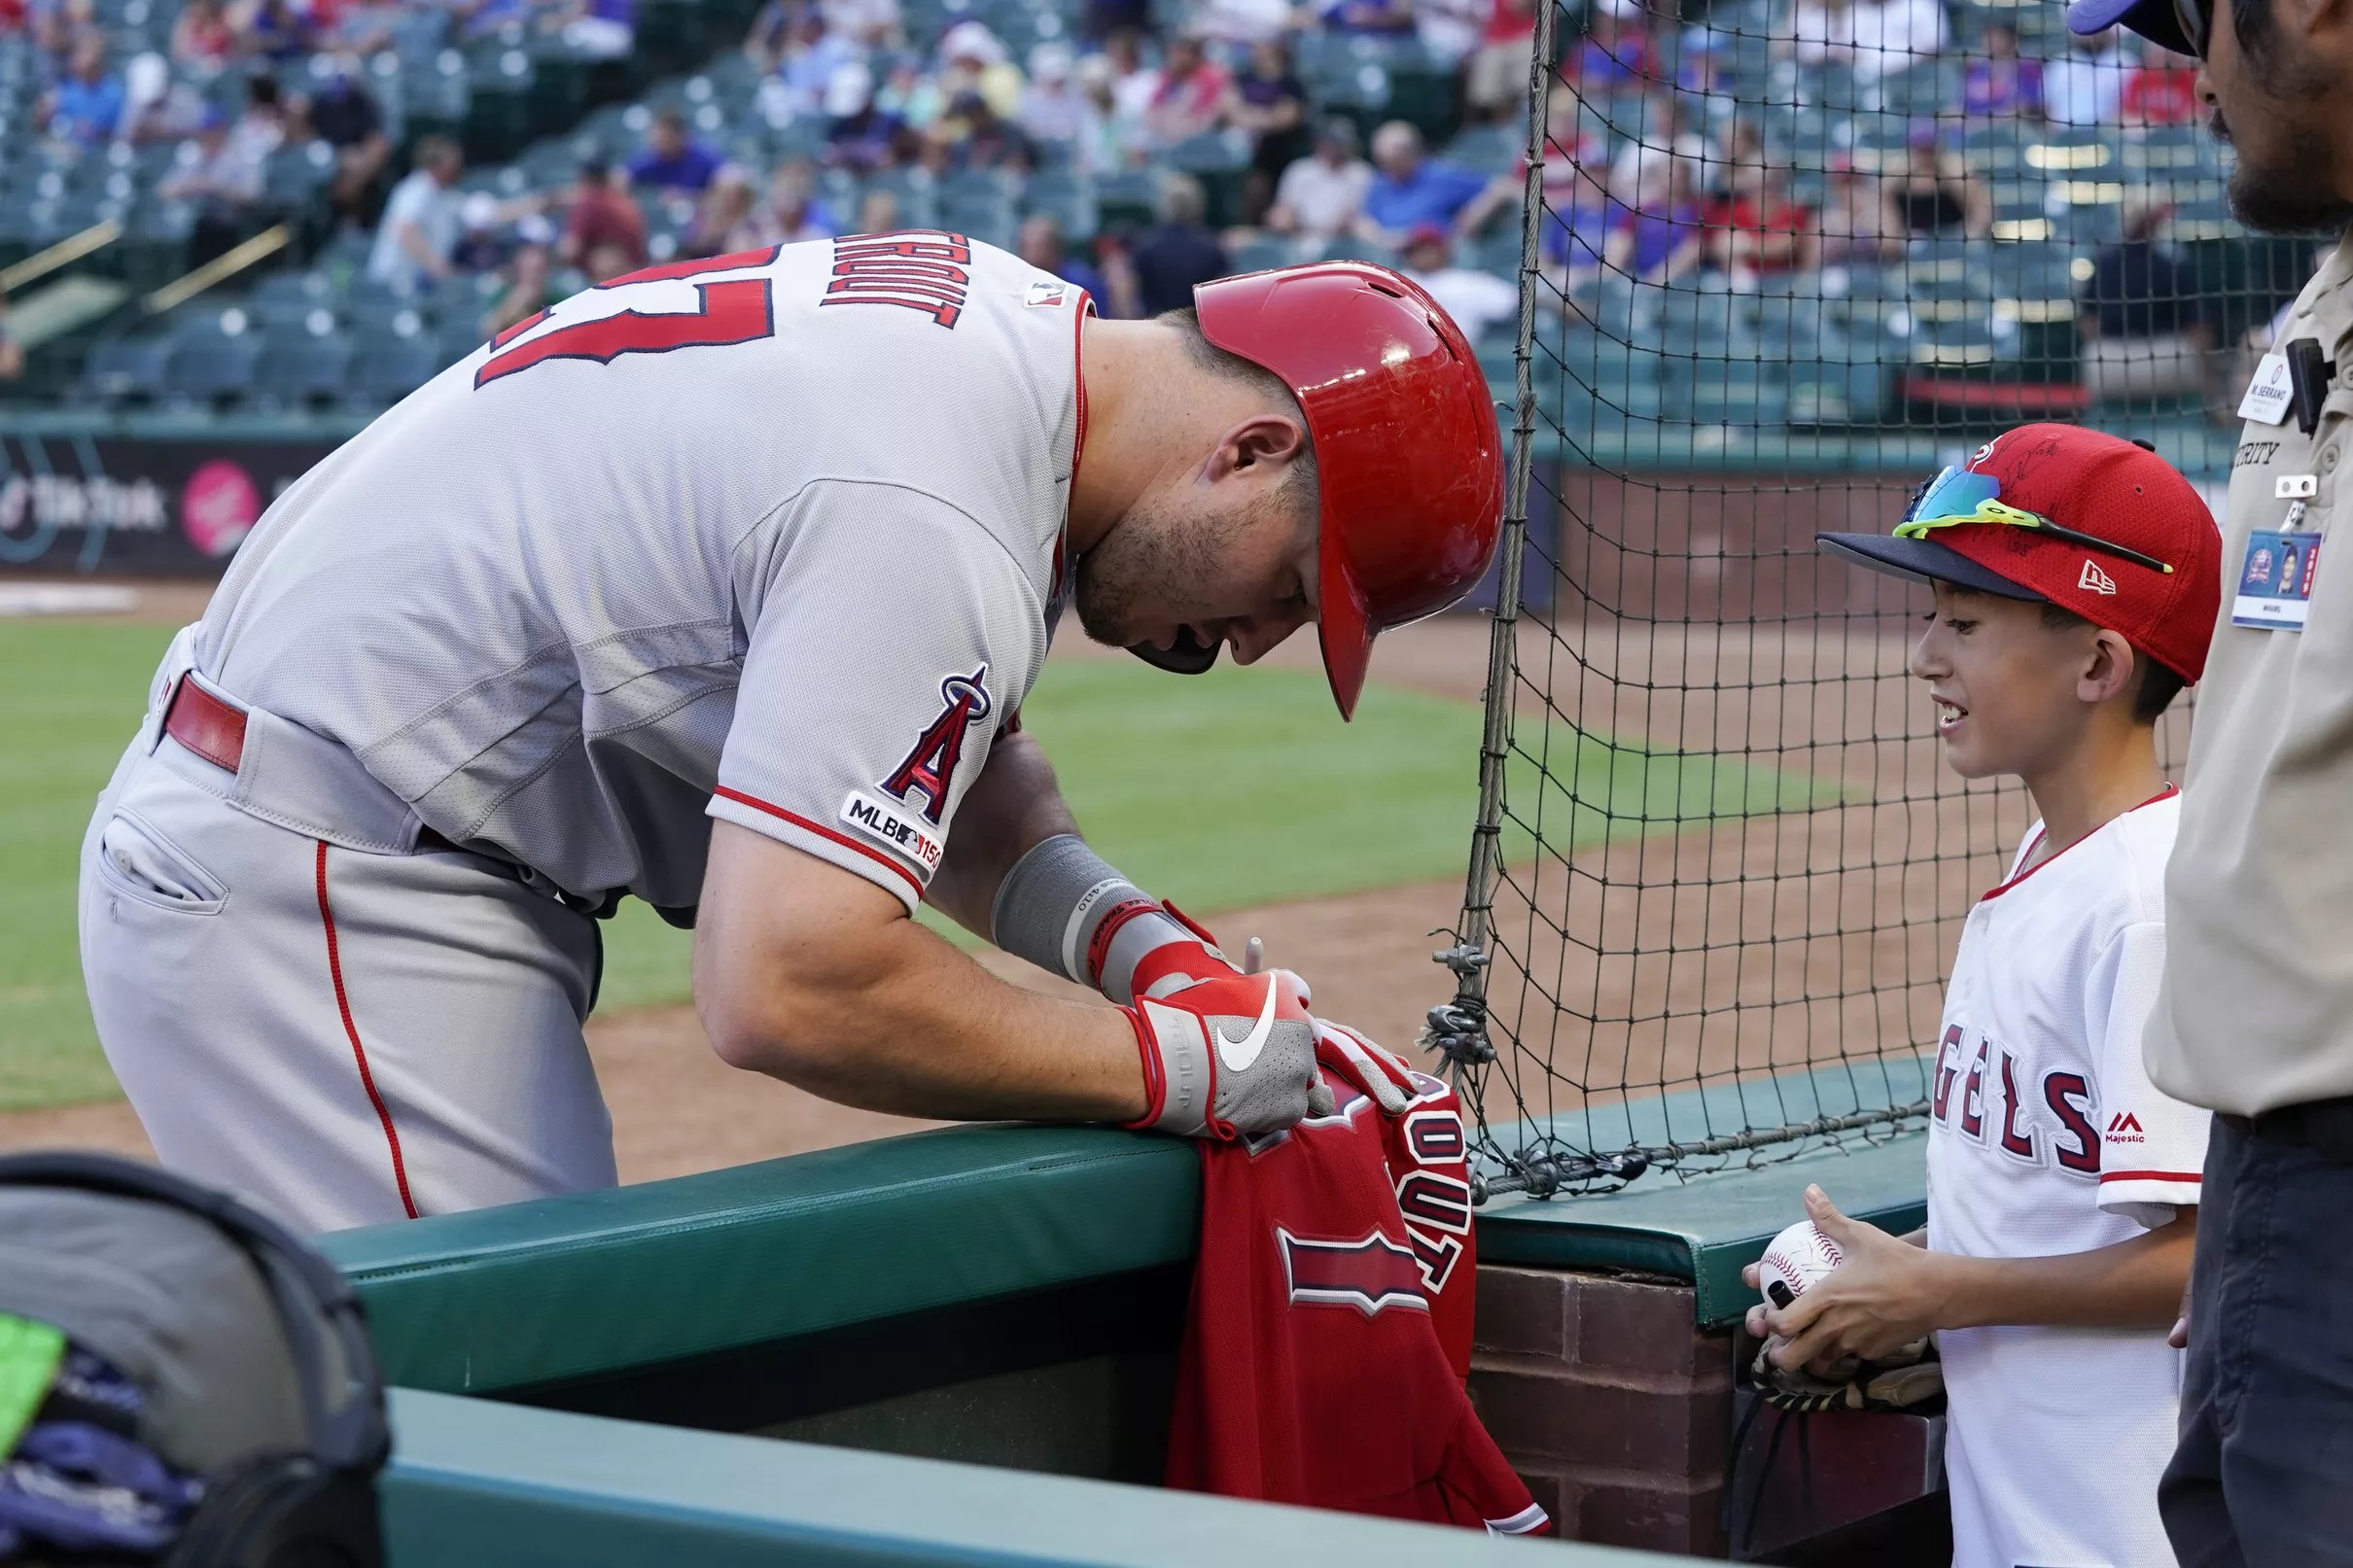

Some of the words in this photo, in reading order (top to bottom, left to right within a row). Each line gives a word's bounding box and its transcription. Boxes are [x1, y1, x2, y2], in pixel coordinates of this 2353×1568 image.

[474, 243, 785, 391] 7
[848, 798, 900, 838] MLB
[2105, 1133, 2145, 1145] Majestic
